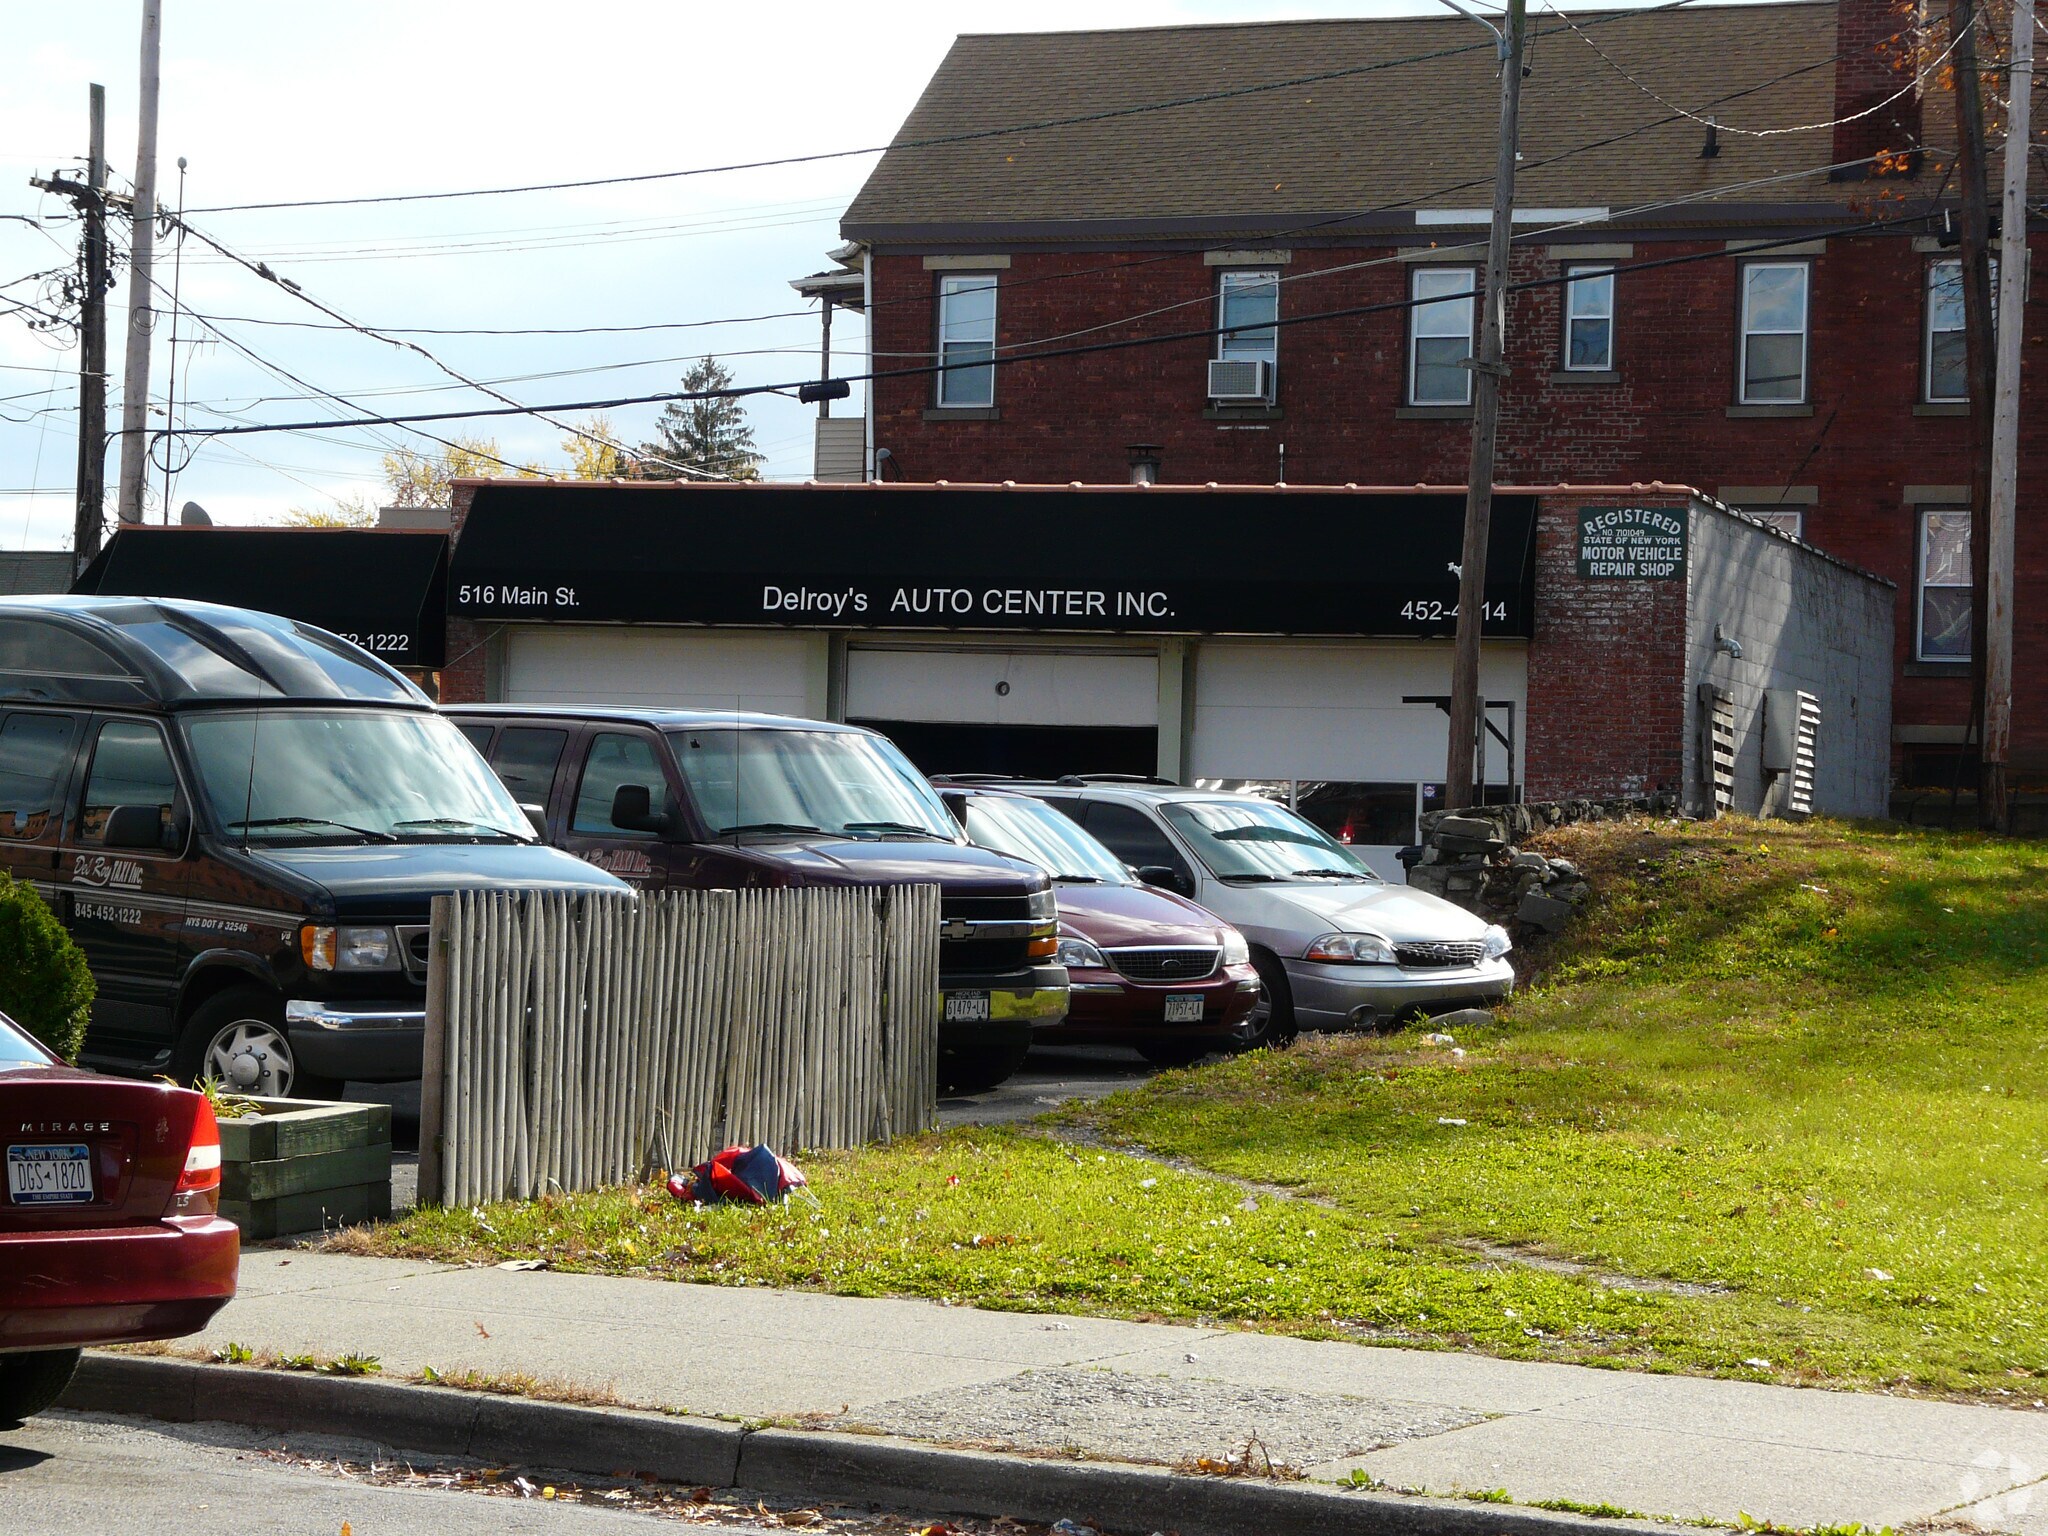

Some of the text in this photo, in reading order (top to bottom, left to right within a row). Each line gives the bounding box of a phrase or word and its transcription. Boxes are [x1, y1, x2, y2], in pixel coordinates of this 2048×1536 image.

[1584, 509, 1681, 535] REGISTERED
[1616, 529, 1645, 537] 7101049
[1584, 536, 1681, 545] STATE OF NEW YORK
[1582, 547, 1682, 560] MOTOR VEHICLE
[1590, 562, 1675, 577] REPAIR SHOP
[459, 585, 580, 606] 516 Main St.
[763, 586, 1176, 617] Delroy's AUTO CENTER INC.
[110, 860, 132, 882] TAXI
[185, 917, 248, 932] NYS DOT # 32546
[21, 1122, 110, 1132] MIRAGE
[28, 1149, 70, 1160] NEW YORK
[176, 1196, 190, 1207] LS
